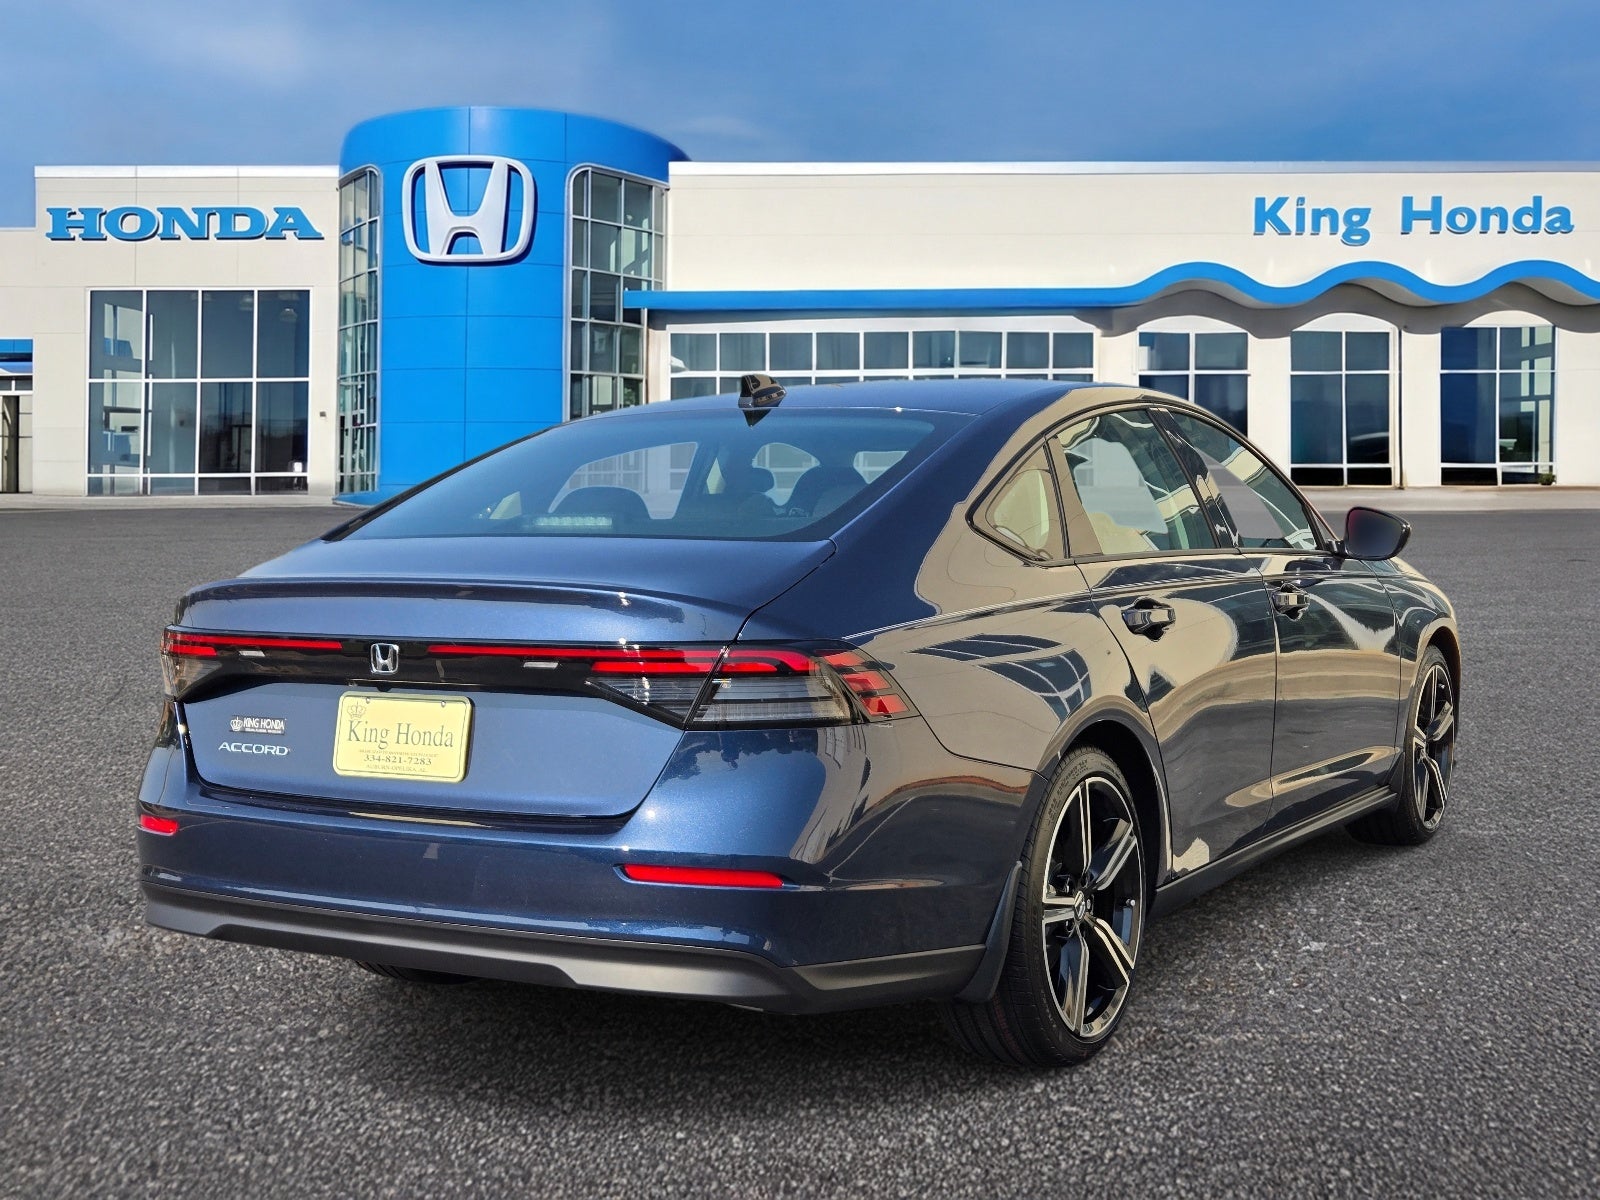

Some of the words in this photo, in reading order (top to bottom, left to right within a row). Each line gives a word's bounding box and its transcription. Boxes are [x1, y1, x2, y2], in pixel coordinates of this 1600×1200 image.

[45, 206, 324, 241] HONDA
[1253, 196, 1372, 246] King
[1400, 195, 1574, 235] Honda
[243, 717, 260, 728] KING
[260, 718, 285, 730] HONDA
[347, 719, 390, 750] King
[395, 722, 453, 747] Honda
[218, 741, 289, 756] ACCORD
[363, 753, 432, 766] 334-821-7283
